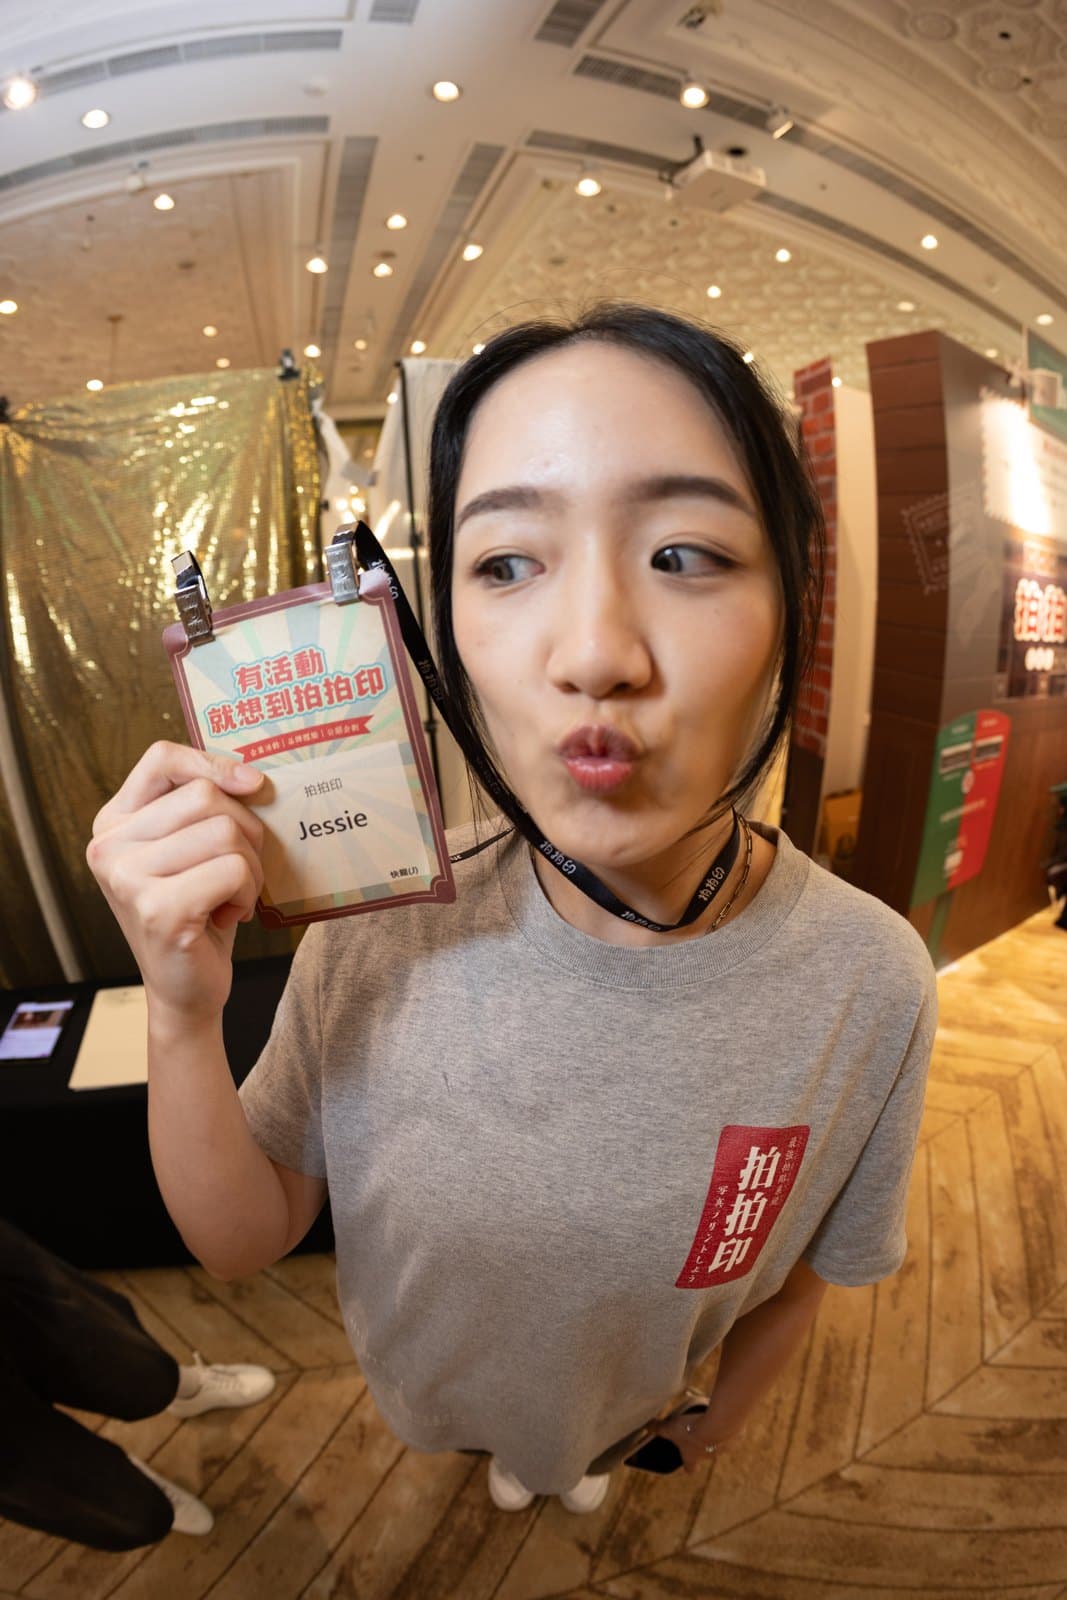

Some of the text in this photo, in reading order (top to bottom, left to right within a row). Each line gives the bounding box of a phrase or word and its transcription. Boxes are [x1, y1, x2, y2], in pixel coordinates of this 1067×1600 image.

[235, 648, 325, 694] 有活動
[207, 666, 384, 734] 就想到拍拍印
[304, 777, 343, 798] 拍拍印
[299, 810, 368, 841] Jessie
[708, 1145, 782, 1273] 拍拍印
